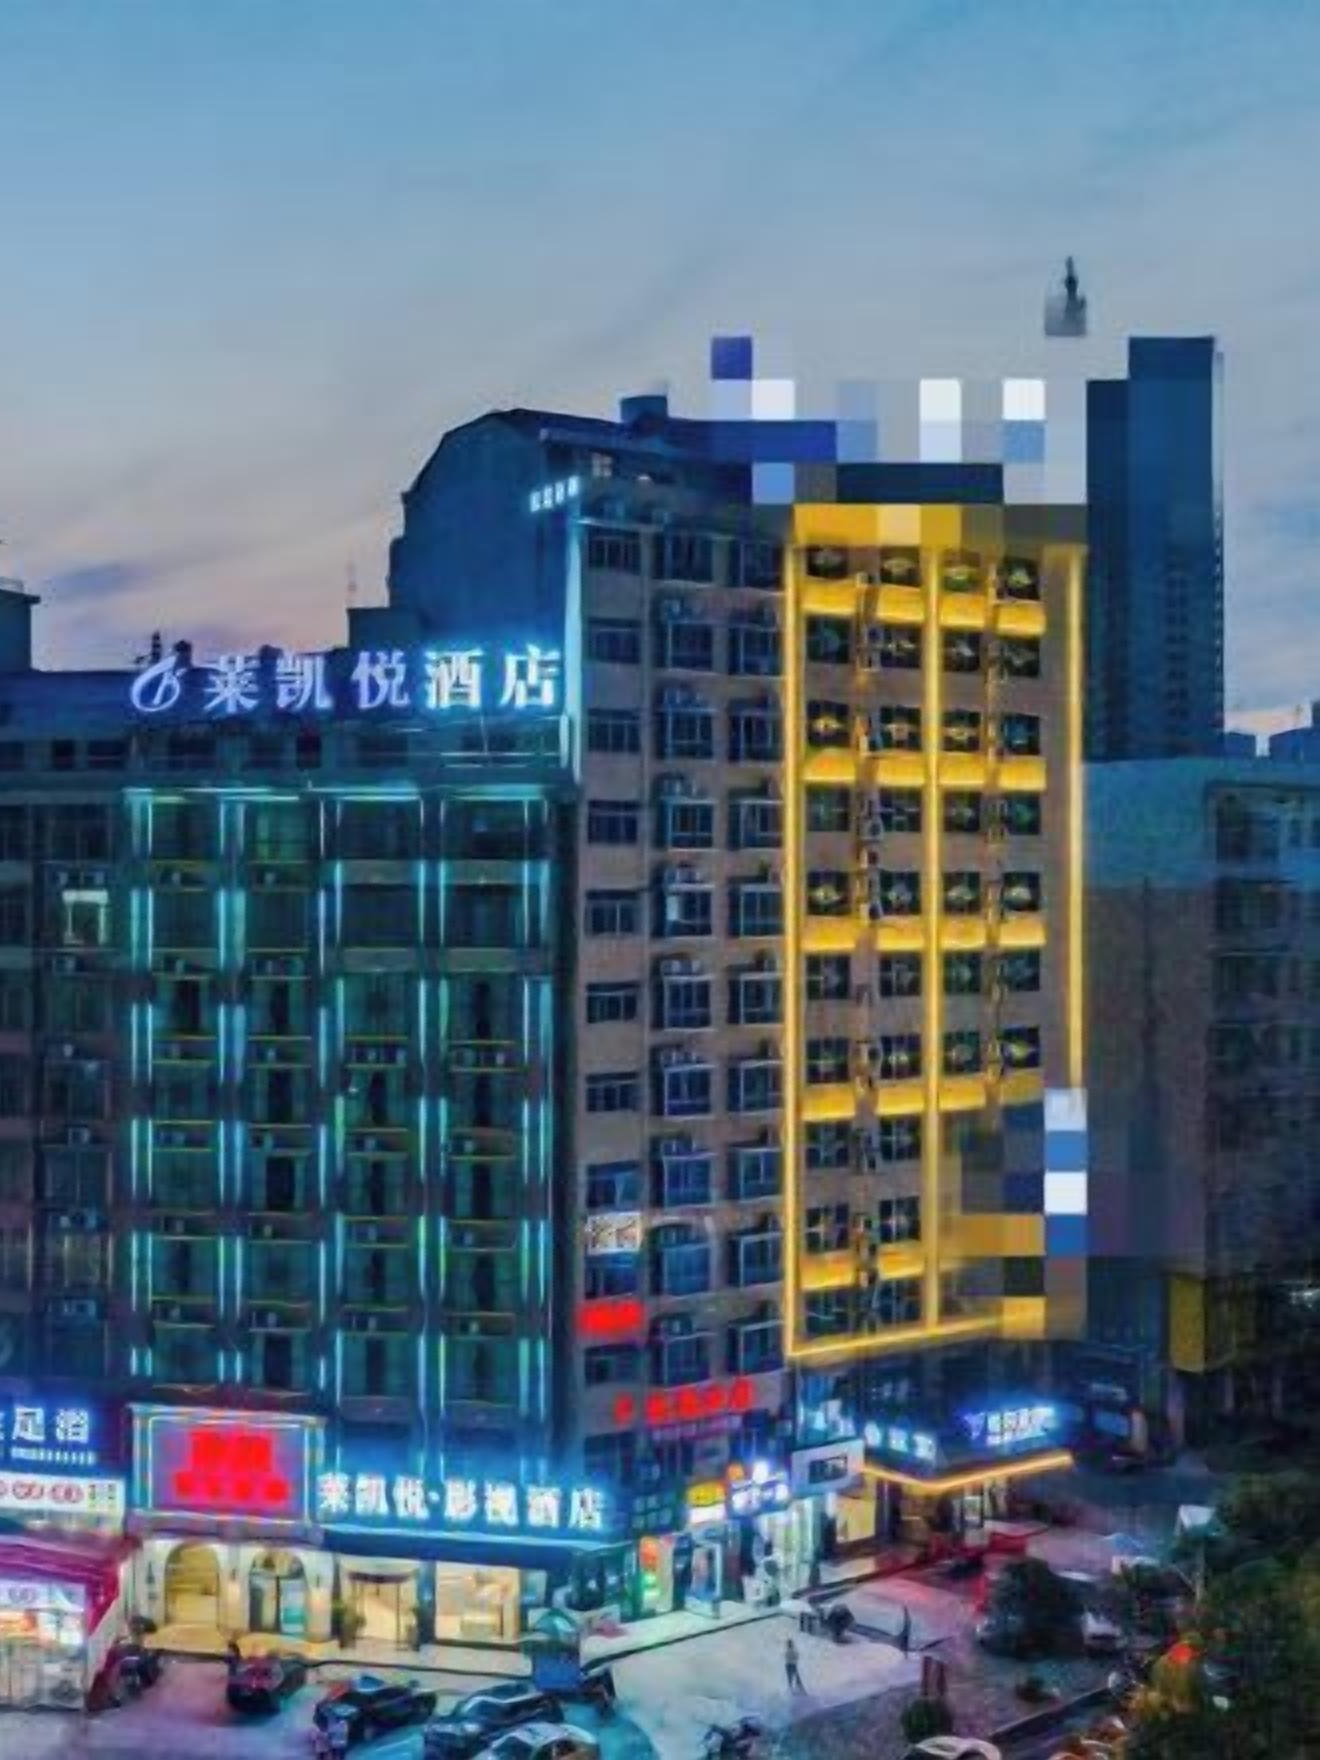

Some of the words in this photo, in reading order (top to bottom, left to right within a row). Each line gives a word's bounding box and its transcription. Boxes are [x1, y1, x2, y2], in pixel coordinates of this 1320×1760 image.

[203, 645, 561, 712] 莱凯悦酒店
